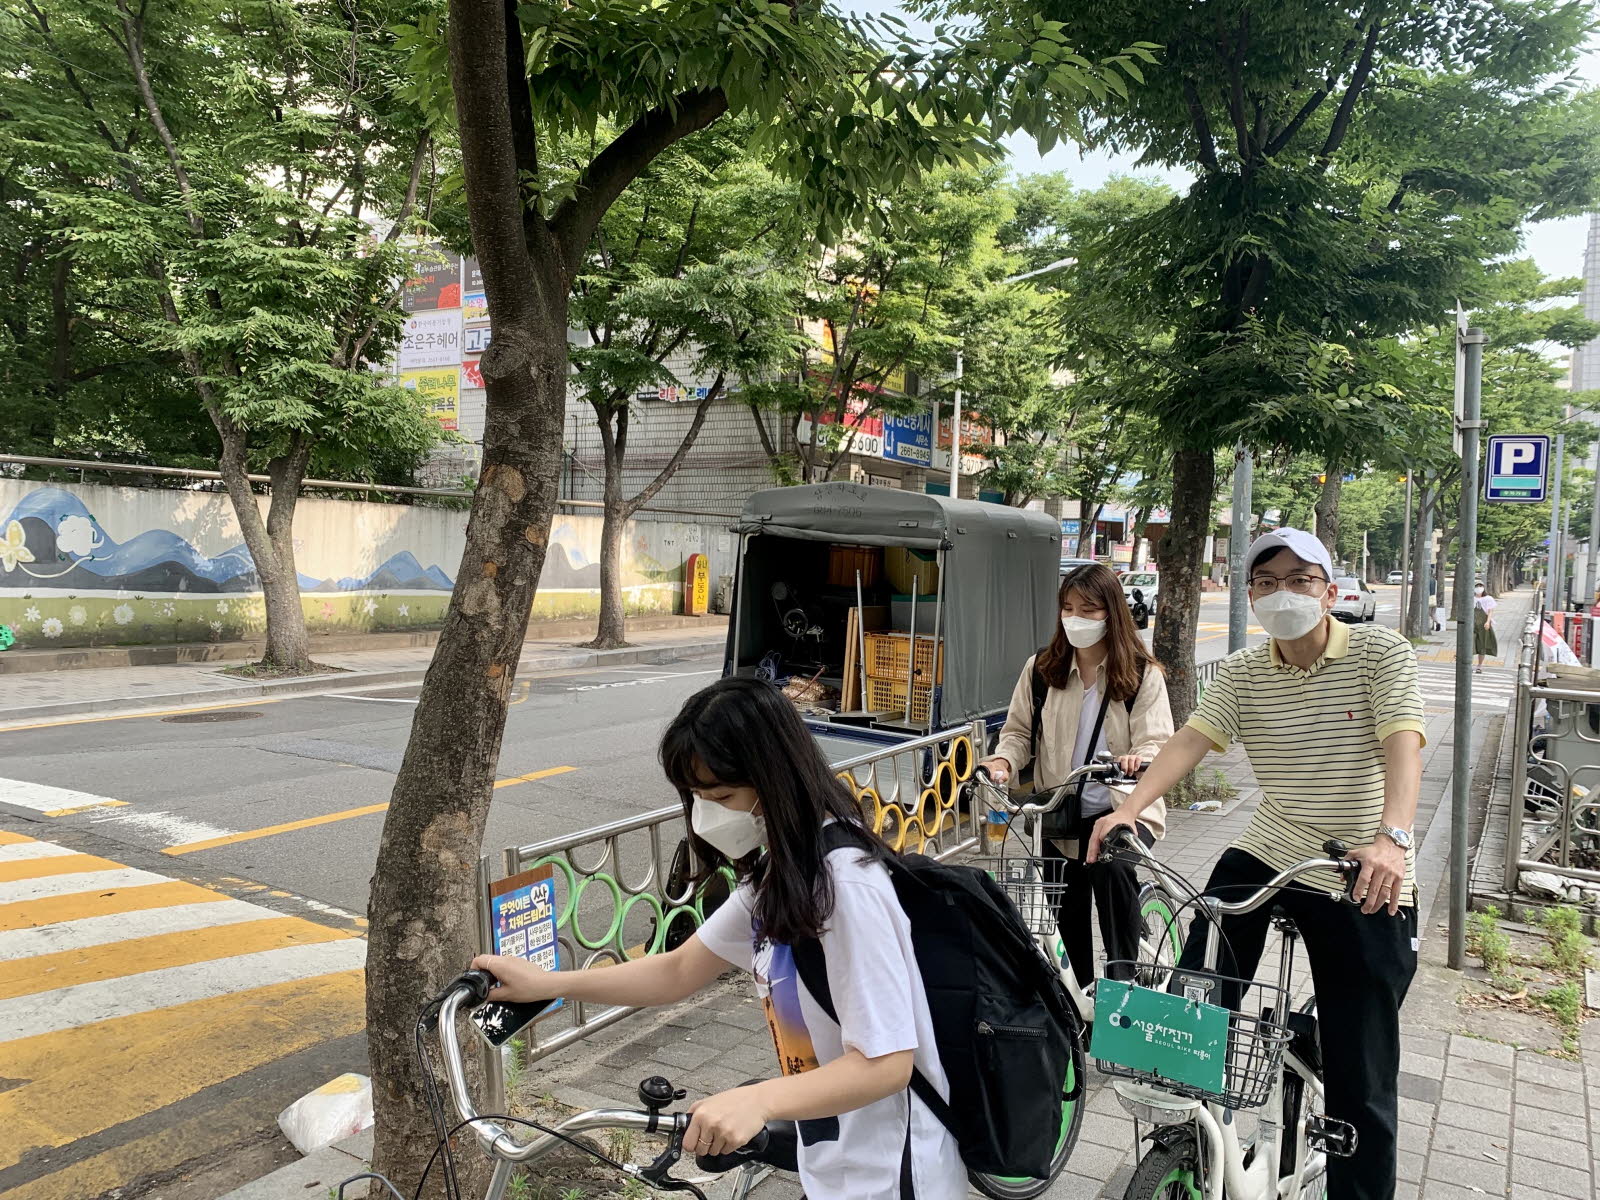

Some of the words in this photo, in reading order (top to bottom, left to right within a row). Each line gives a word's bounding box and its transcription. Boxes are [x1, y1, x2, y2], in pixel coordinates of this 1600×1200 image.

[1500, 442, 1535, 474] P
[696, 571, 706, 605] 부동산
[500, 895, 530, 916] 무엇이든
[533, 887, 548, 905] 싹
[509, 903, 552, 929] 치워드립니다
[1132, 1019, 1193, 1045] 서울자전거
[1154, 1039, 1175, 1049] SEOUL
[1177, 1045, 1191, 1053] BIKE
[1193, 1049, 1211, 1061] 따릉이
